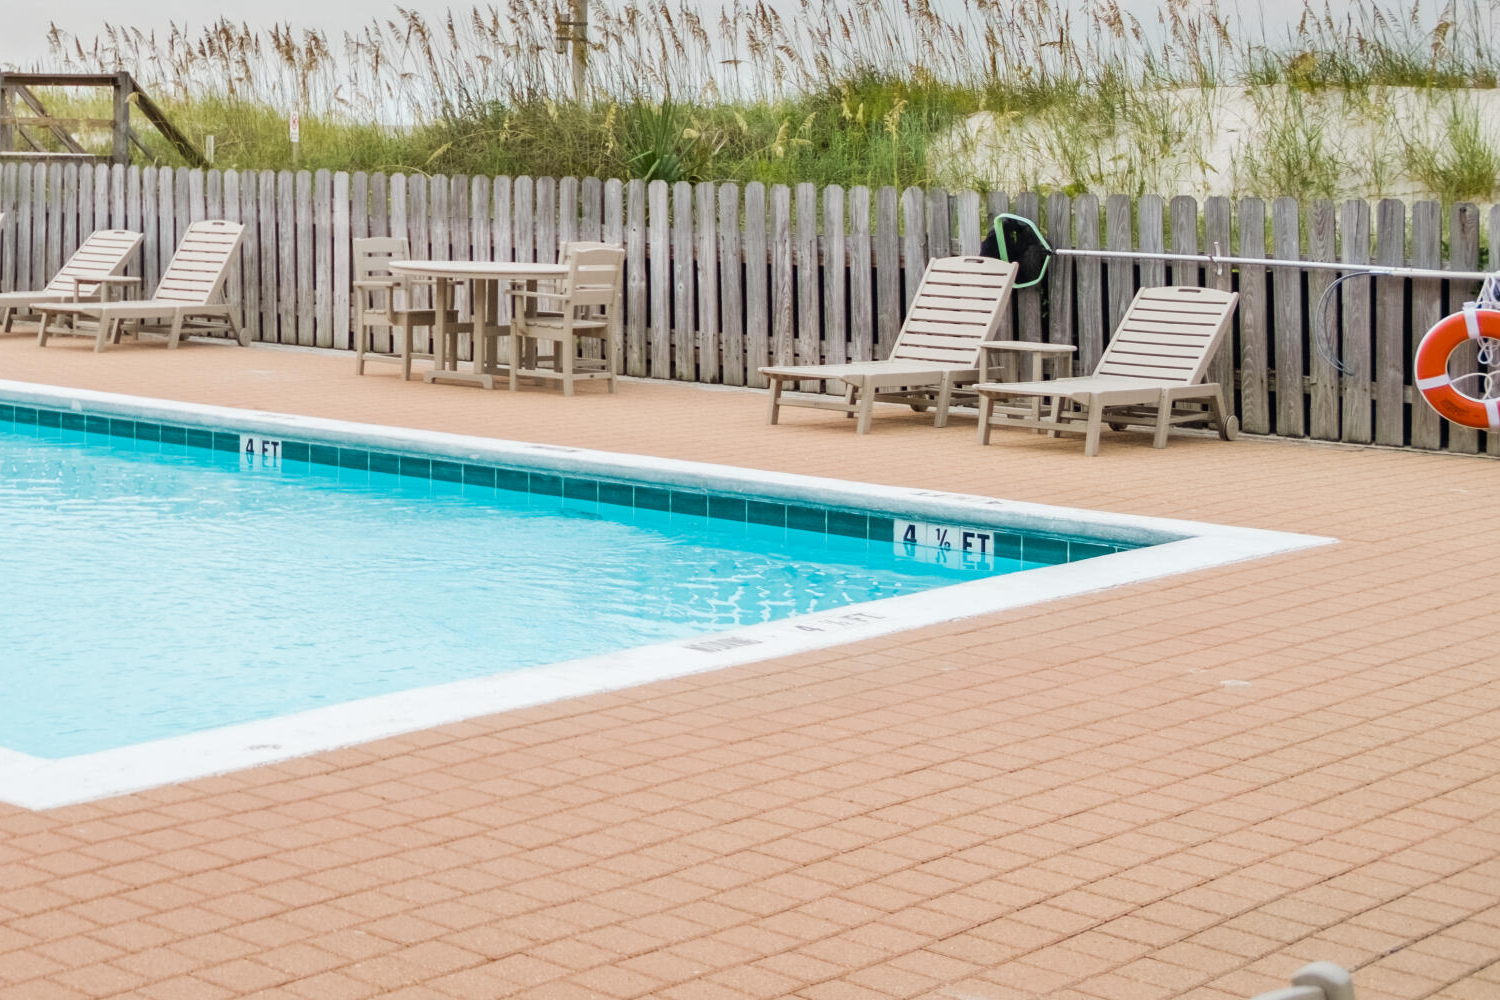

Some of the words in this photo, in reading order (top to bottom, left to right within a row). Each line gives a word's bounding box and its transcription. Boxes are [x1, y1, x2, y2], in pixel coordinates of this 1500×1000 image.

[245, 438, 255, 454] 4
[261, 440, 280, 457] FT
[903, 524, 918, 543] 4
[962, 531, 991, 554] FT
